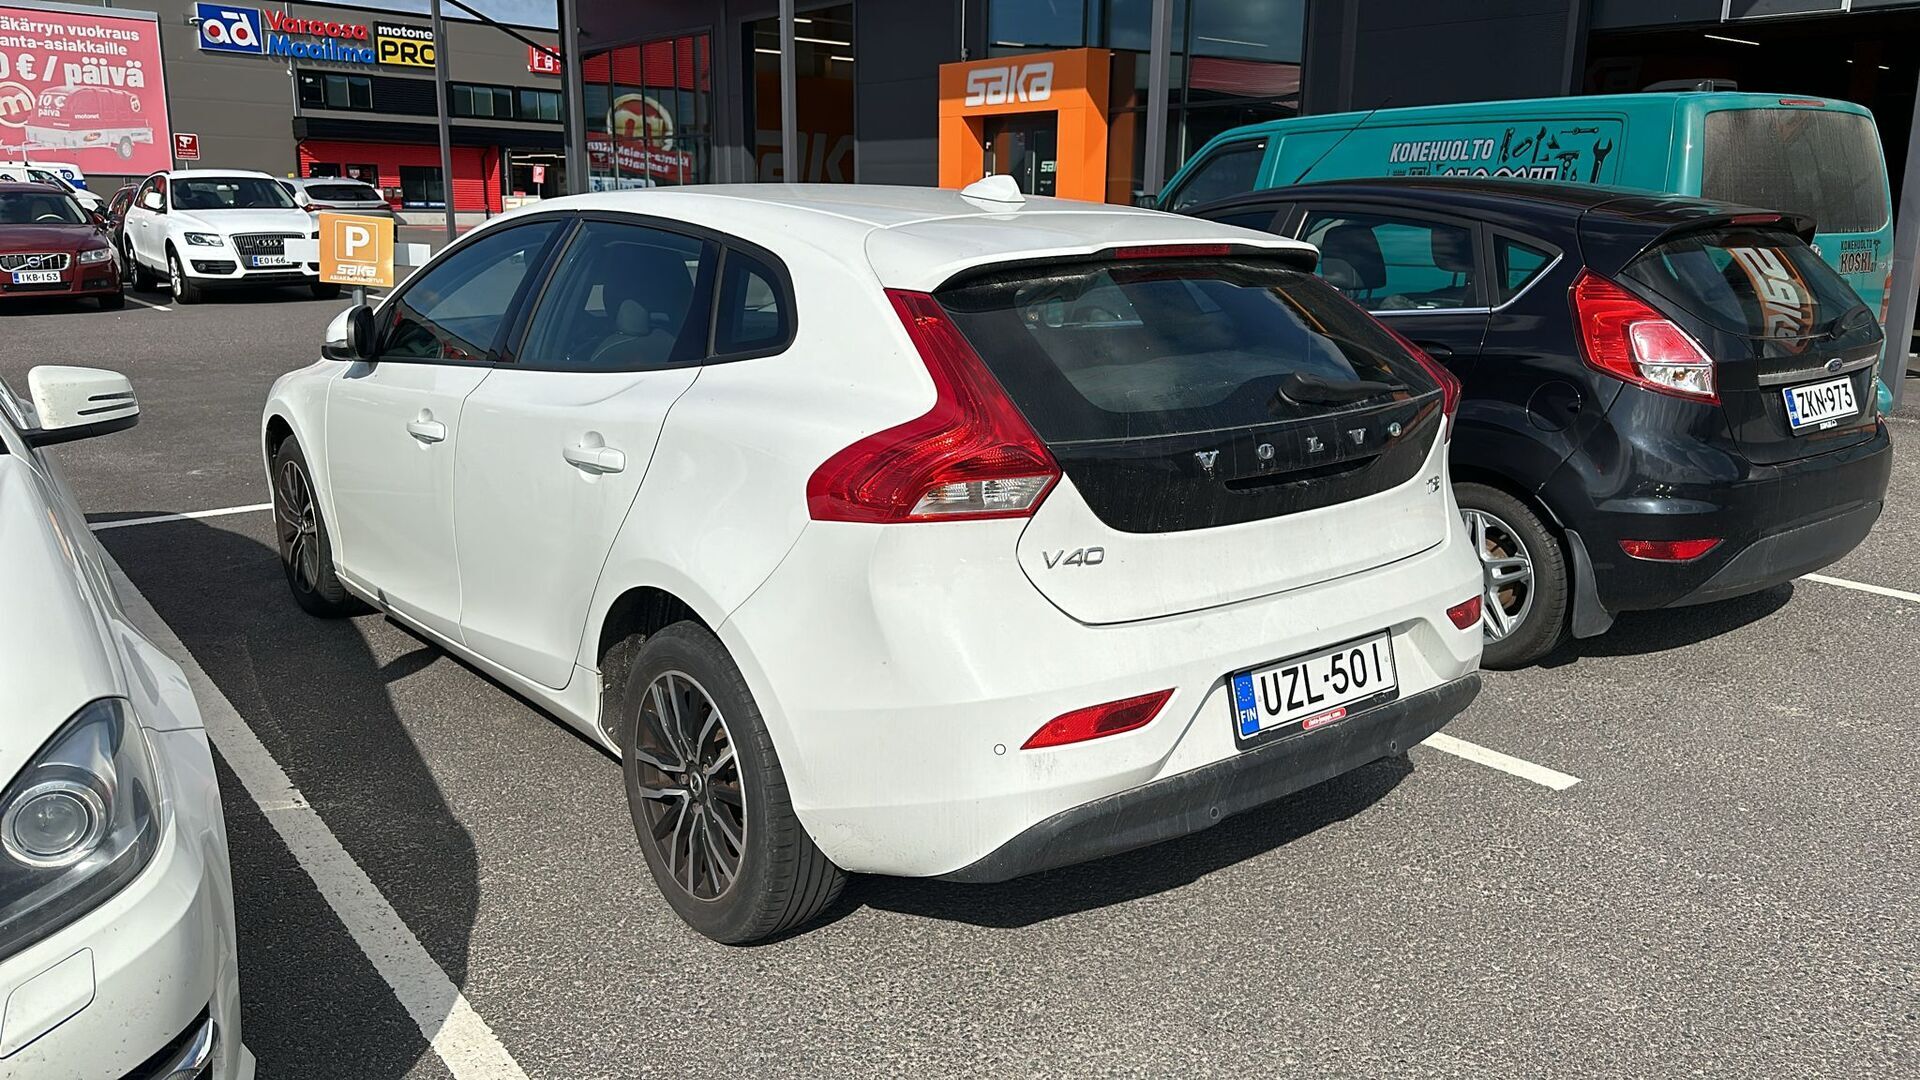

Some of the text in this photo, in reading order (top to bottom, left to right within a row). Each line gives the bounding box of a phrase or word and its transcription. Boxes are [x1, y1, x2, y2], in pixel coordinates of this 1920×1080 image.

[67, 24, 140, 41] vuokraus
[263, 9, 368, 40] Varaosa
[378, 26, 433, 40] motone
[267, 33, 375, 64] Maailma
[381, 40, 435, 65] PRO
[64, 56, 145, 92] päivä
[38, 94, 52, 107] 10
[38, 106, 61, 118] päivä
[1389, 139, 1495, 163] KONEHUOLTO
[345, 225, 370, 257] P
[1839, 250, 1871, 274] KOSKI
[1796, 383, 1853, 418] ZKN-973
[1042, 546, 1105, 569] V40
[1260, 643, 1382, 716] UZL-501
[1240, 708, 1257, 724] FIN
